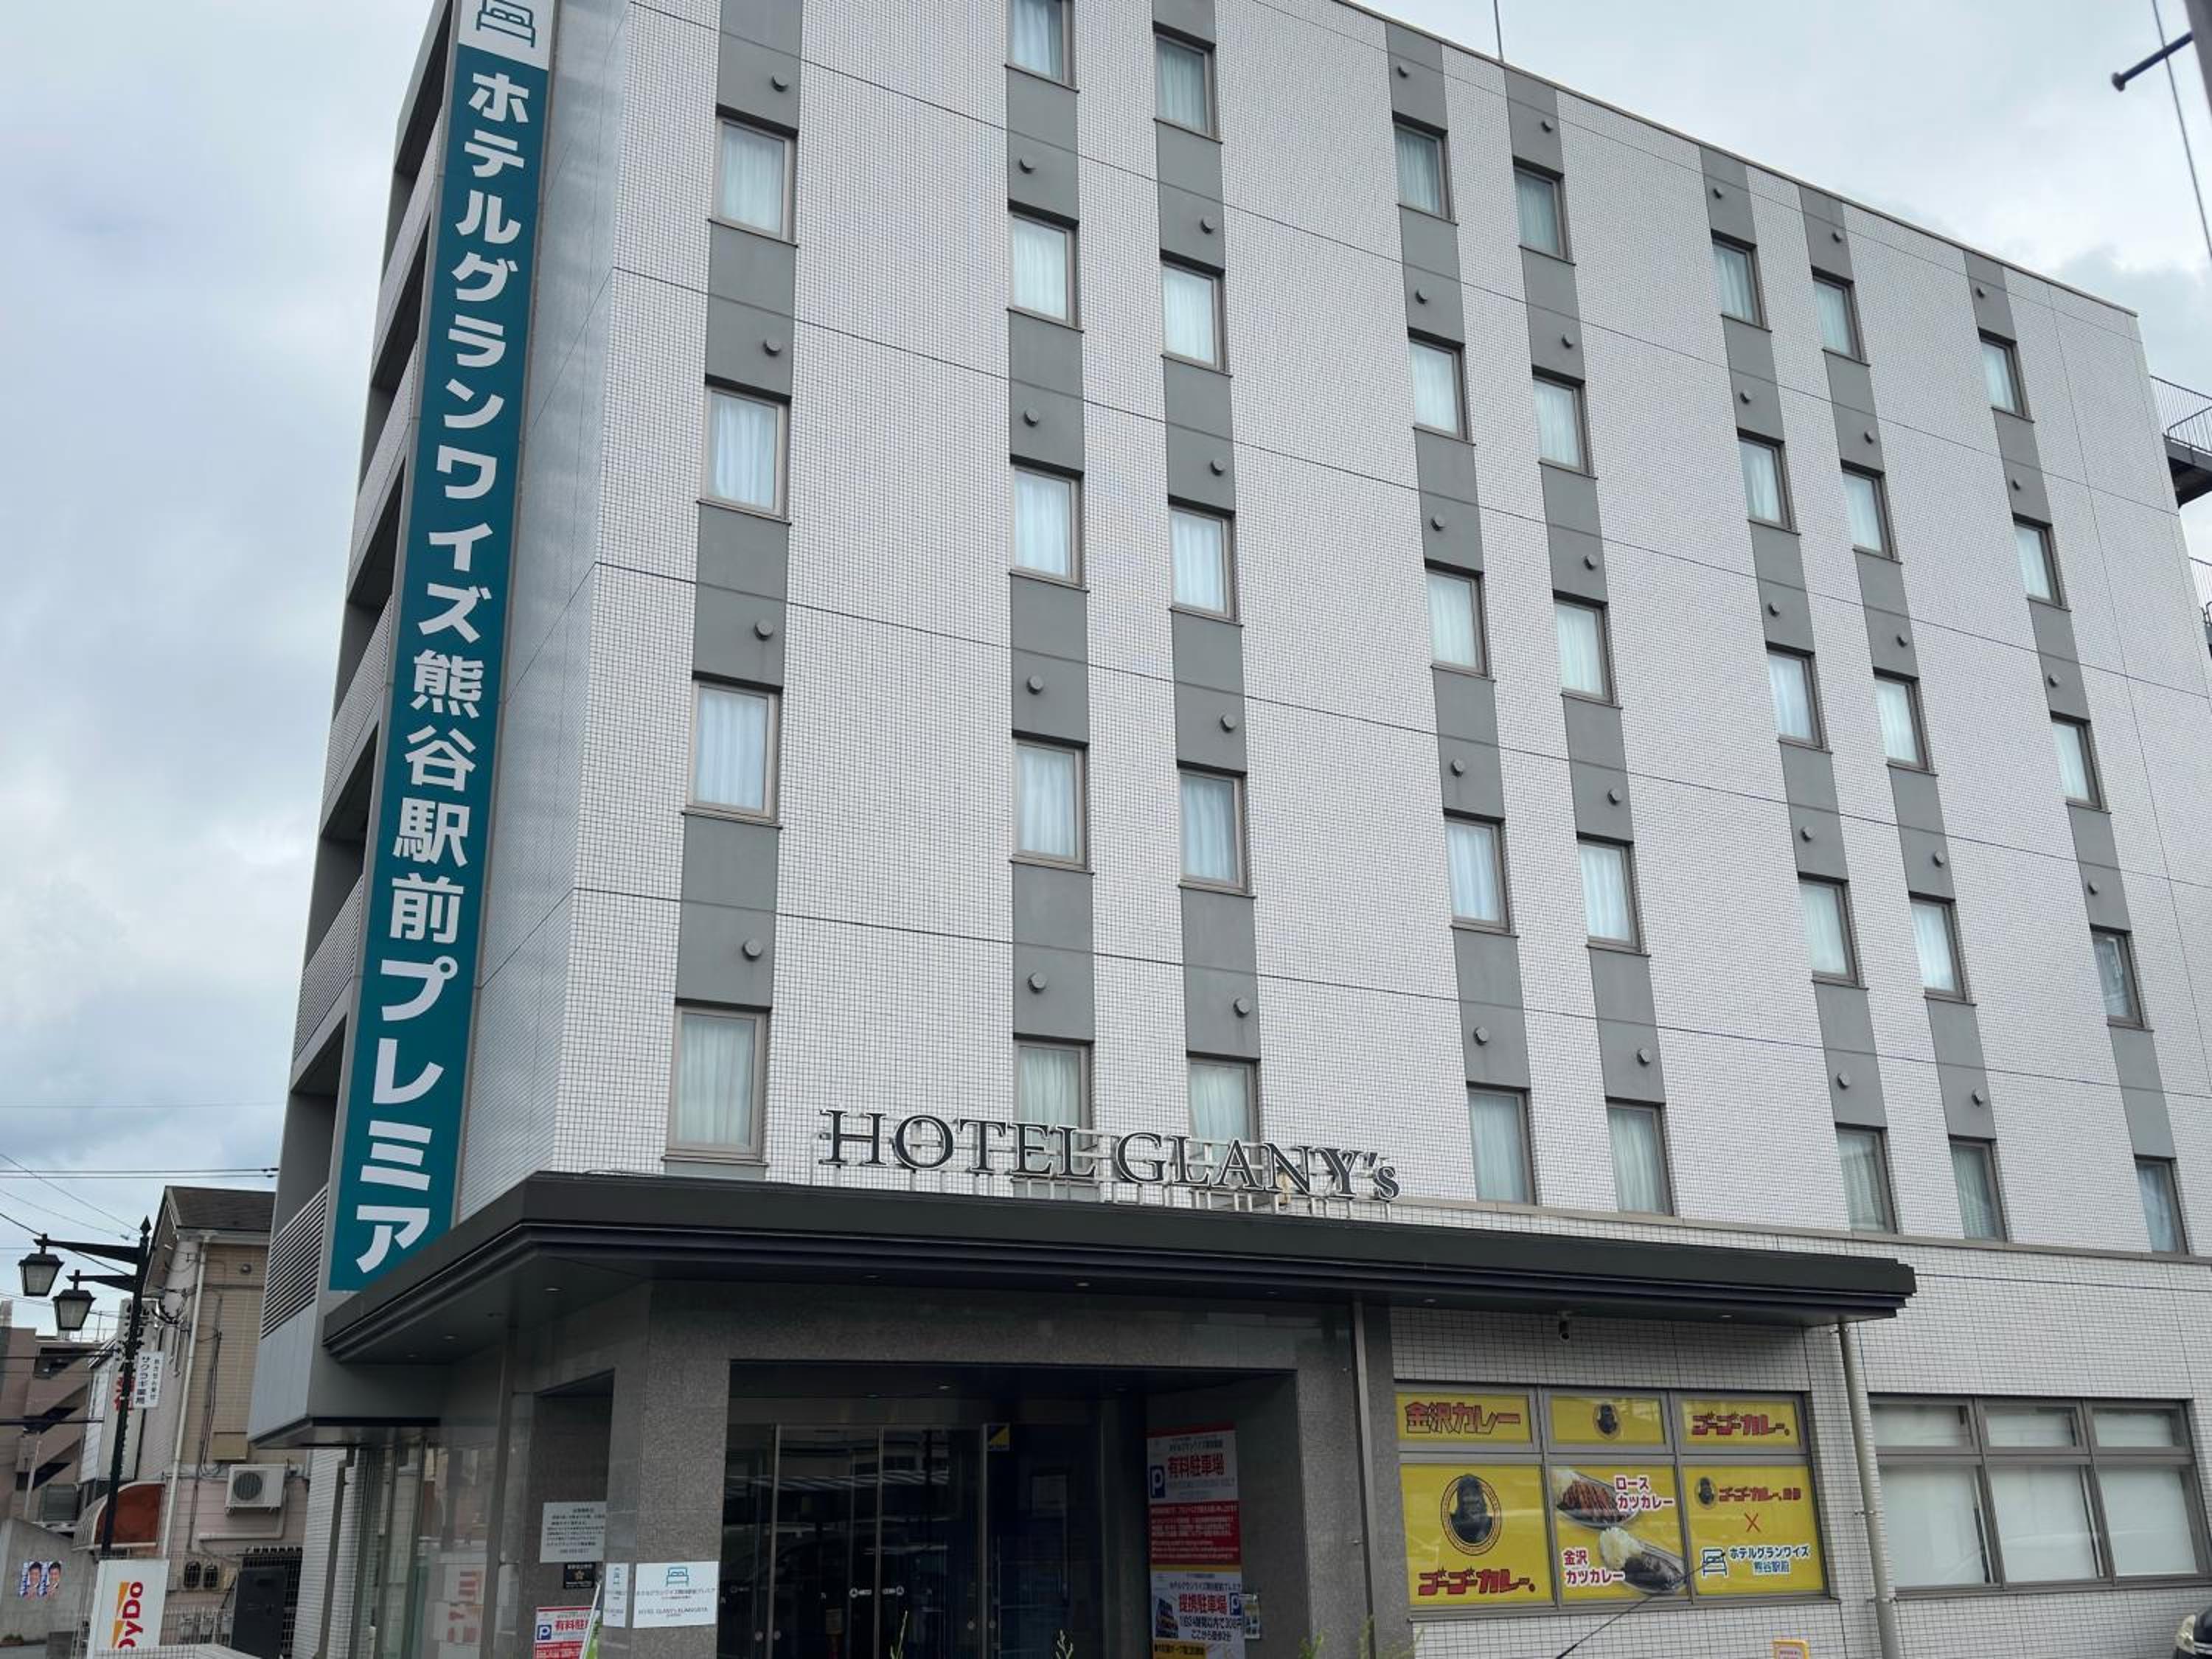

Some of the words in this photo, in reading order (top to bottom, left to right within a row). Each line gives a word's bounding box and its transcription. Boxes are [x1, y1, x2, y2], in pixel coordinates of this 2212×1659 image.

[356, 72, 531, 1273] ホテルグランワイズ熊谷駅前プレミア
[819, 1108, 1098, 1180] HOTEL
[1113, 1131, 1402, 1201] GLANY's
[1405, 1401, 1521, 1434] 金沢カレー
[1615, 1476, 1649, 1492] ロース
[1617, 1493, 1674, 1510] カツカレー
[1563, 1550, 1587, 1565] 金沢
[1729, 1545, 1809, 1559] ホテルグランワイズ
[1565, 1569, 1626, 1586] カツカレー
